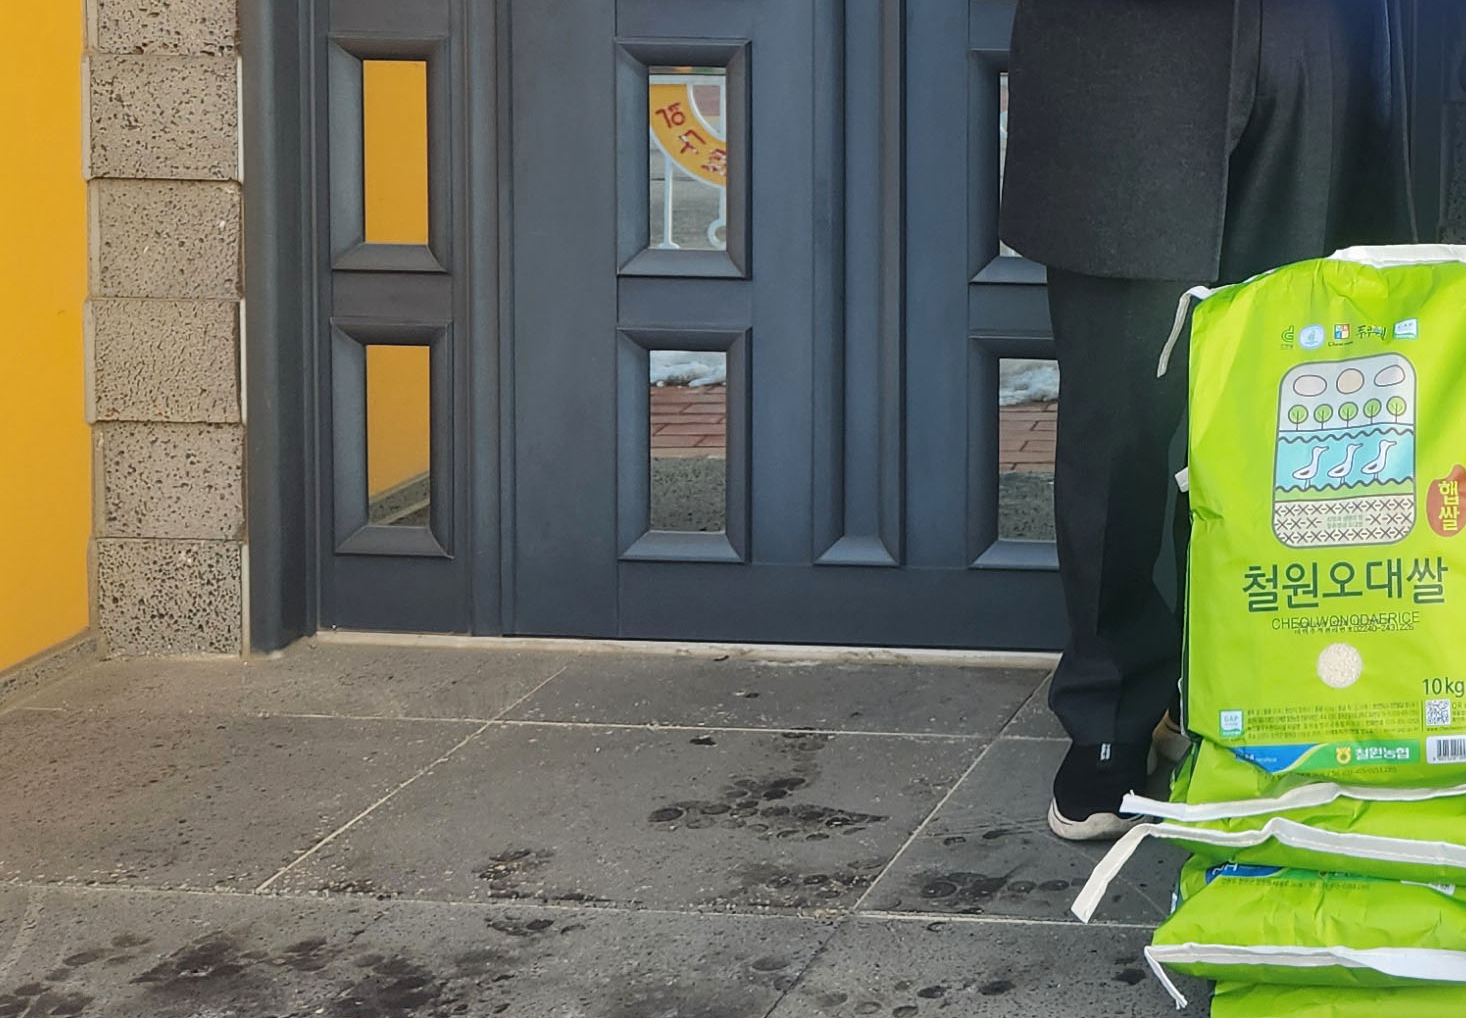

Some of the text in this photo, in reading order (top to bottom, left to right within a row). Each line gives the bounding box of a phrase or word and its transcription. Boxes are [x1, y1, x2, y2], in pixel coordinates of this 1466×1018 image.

[1438, 480, 1460, 532] 햅쌀
[1242, 556, 1449, 613] 철원오대쌀
[1271, 611, 1421, 631] CHEOLWONODAERICE
[1422, 676, 1465, 698] 10kg
[1355, 747, 1410, 761] 철원농협
